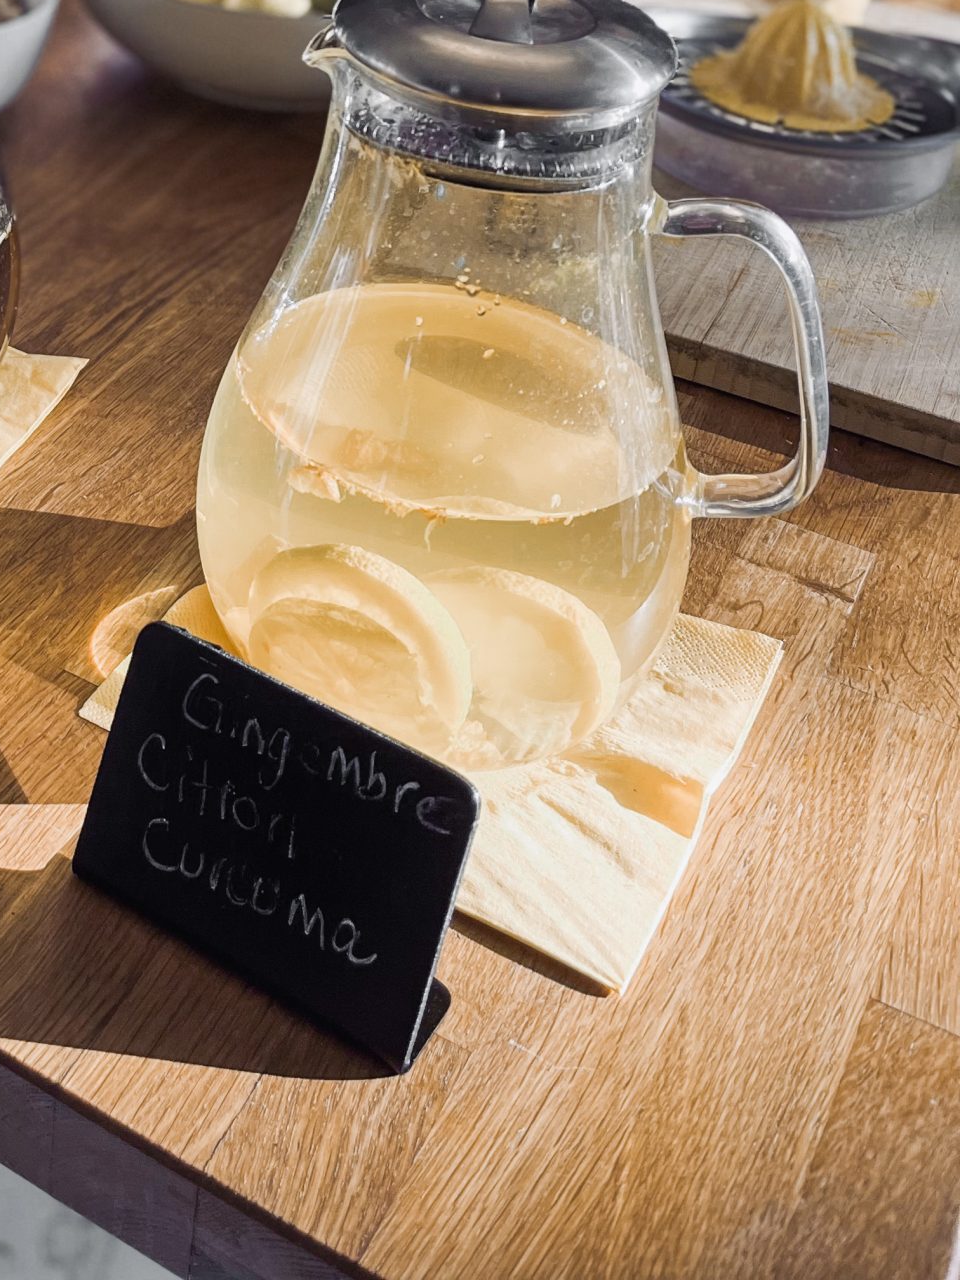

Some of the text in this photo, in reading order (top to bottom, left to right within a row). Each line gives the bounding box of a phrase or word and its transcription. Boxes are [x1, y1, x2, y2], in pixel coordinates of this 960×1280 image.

[138, 733, 296, 859] Citron
[182, 673, 453, 834] Gingembre
[142, 818, 378, 965] Curcuma
